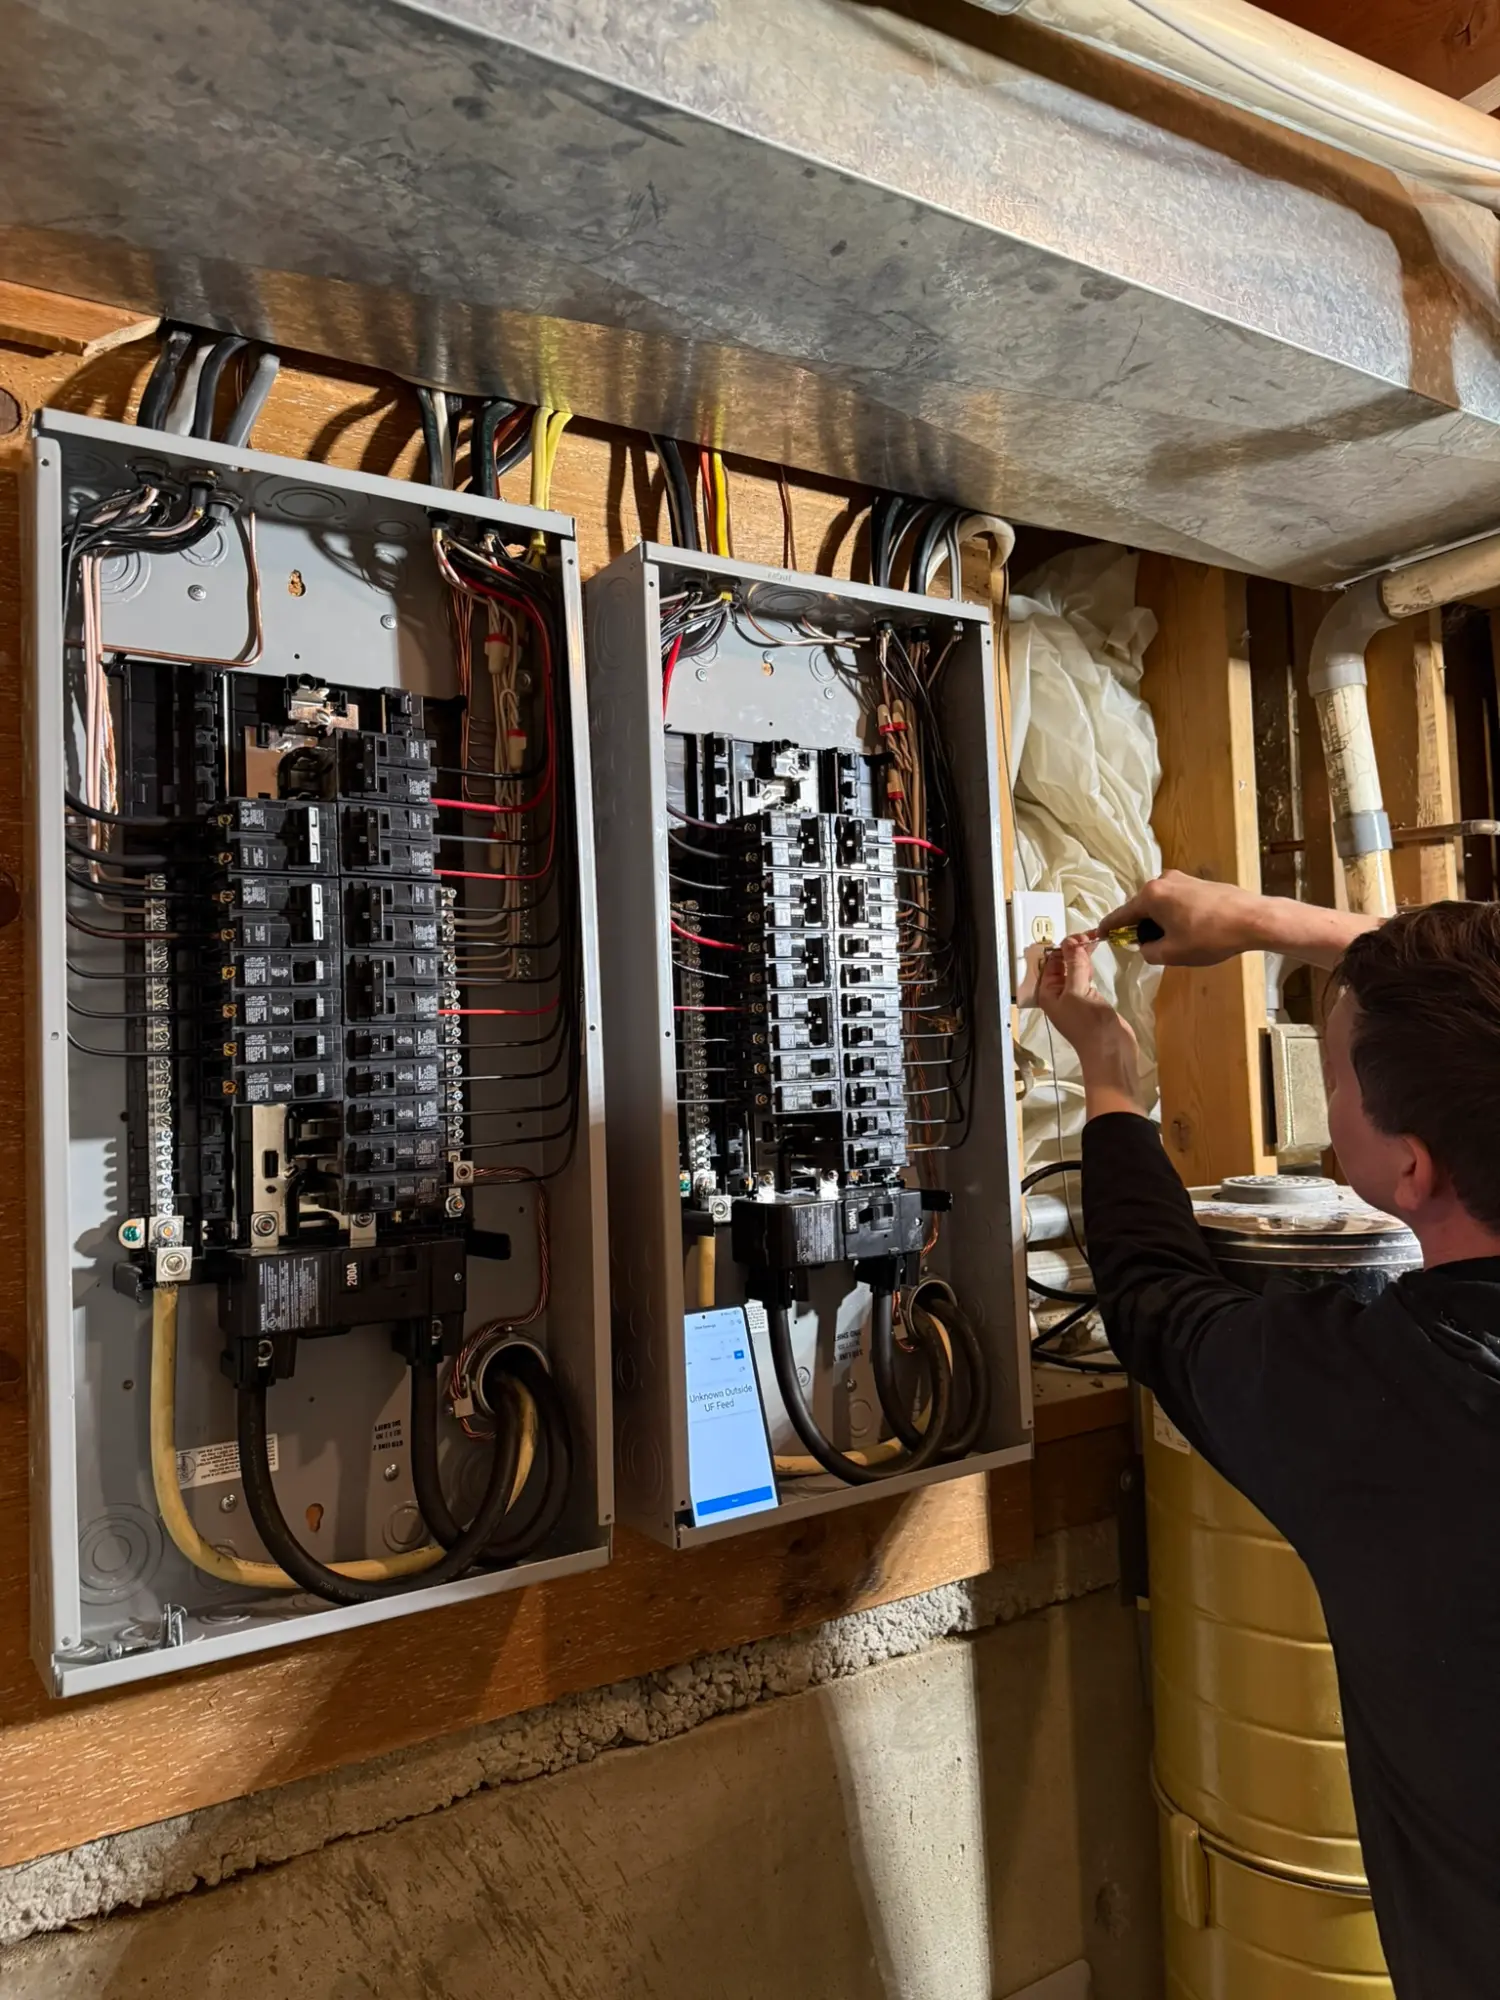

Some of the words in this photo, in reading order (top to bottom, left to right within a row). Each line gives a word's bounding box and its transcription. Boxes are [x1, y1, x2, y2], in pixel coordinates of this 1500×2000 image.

[848, 1211, 857, 1230] 200A
[346, 1261, 358, 1287] 200A
[689, 1390, 724, 1403] Unknown
[725, 1384, 753, 1397] Outside
[704, 1402, 715, 1412] UF
[716, 1399, 735, 1410] Feed
